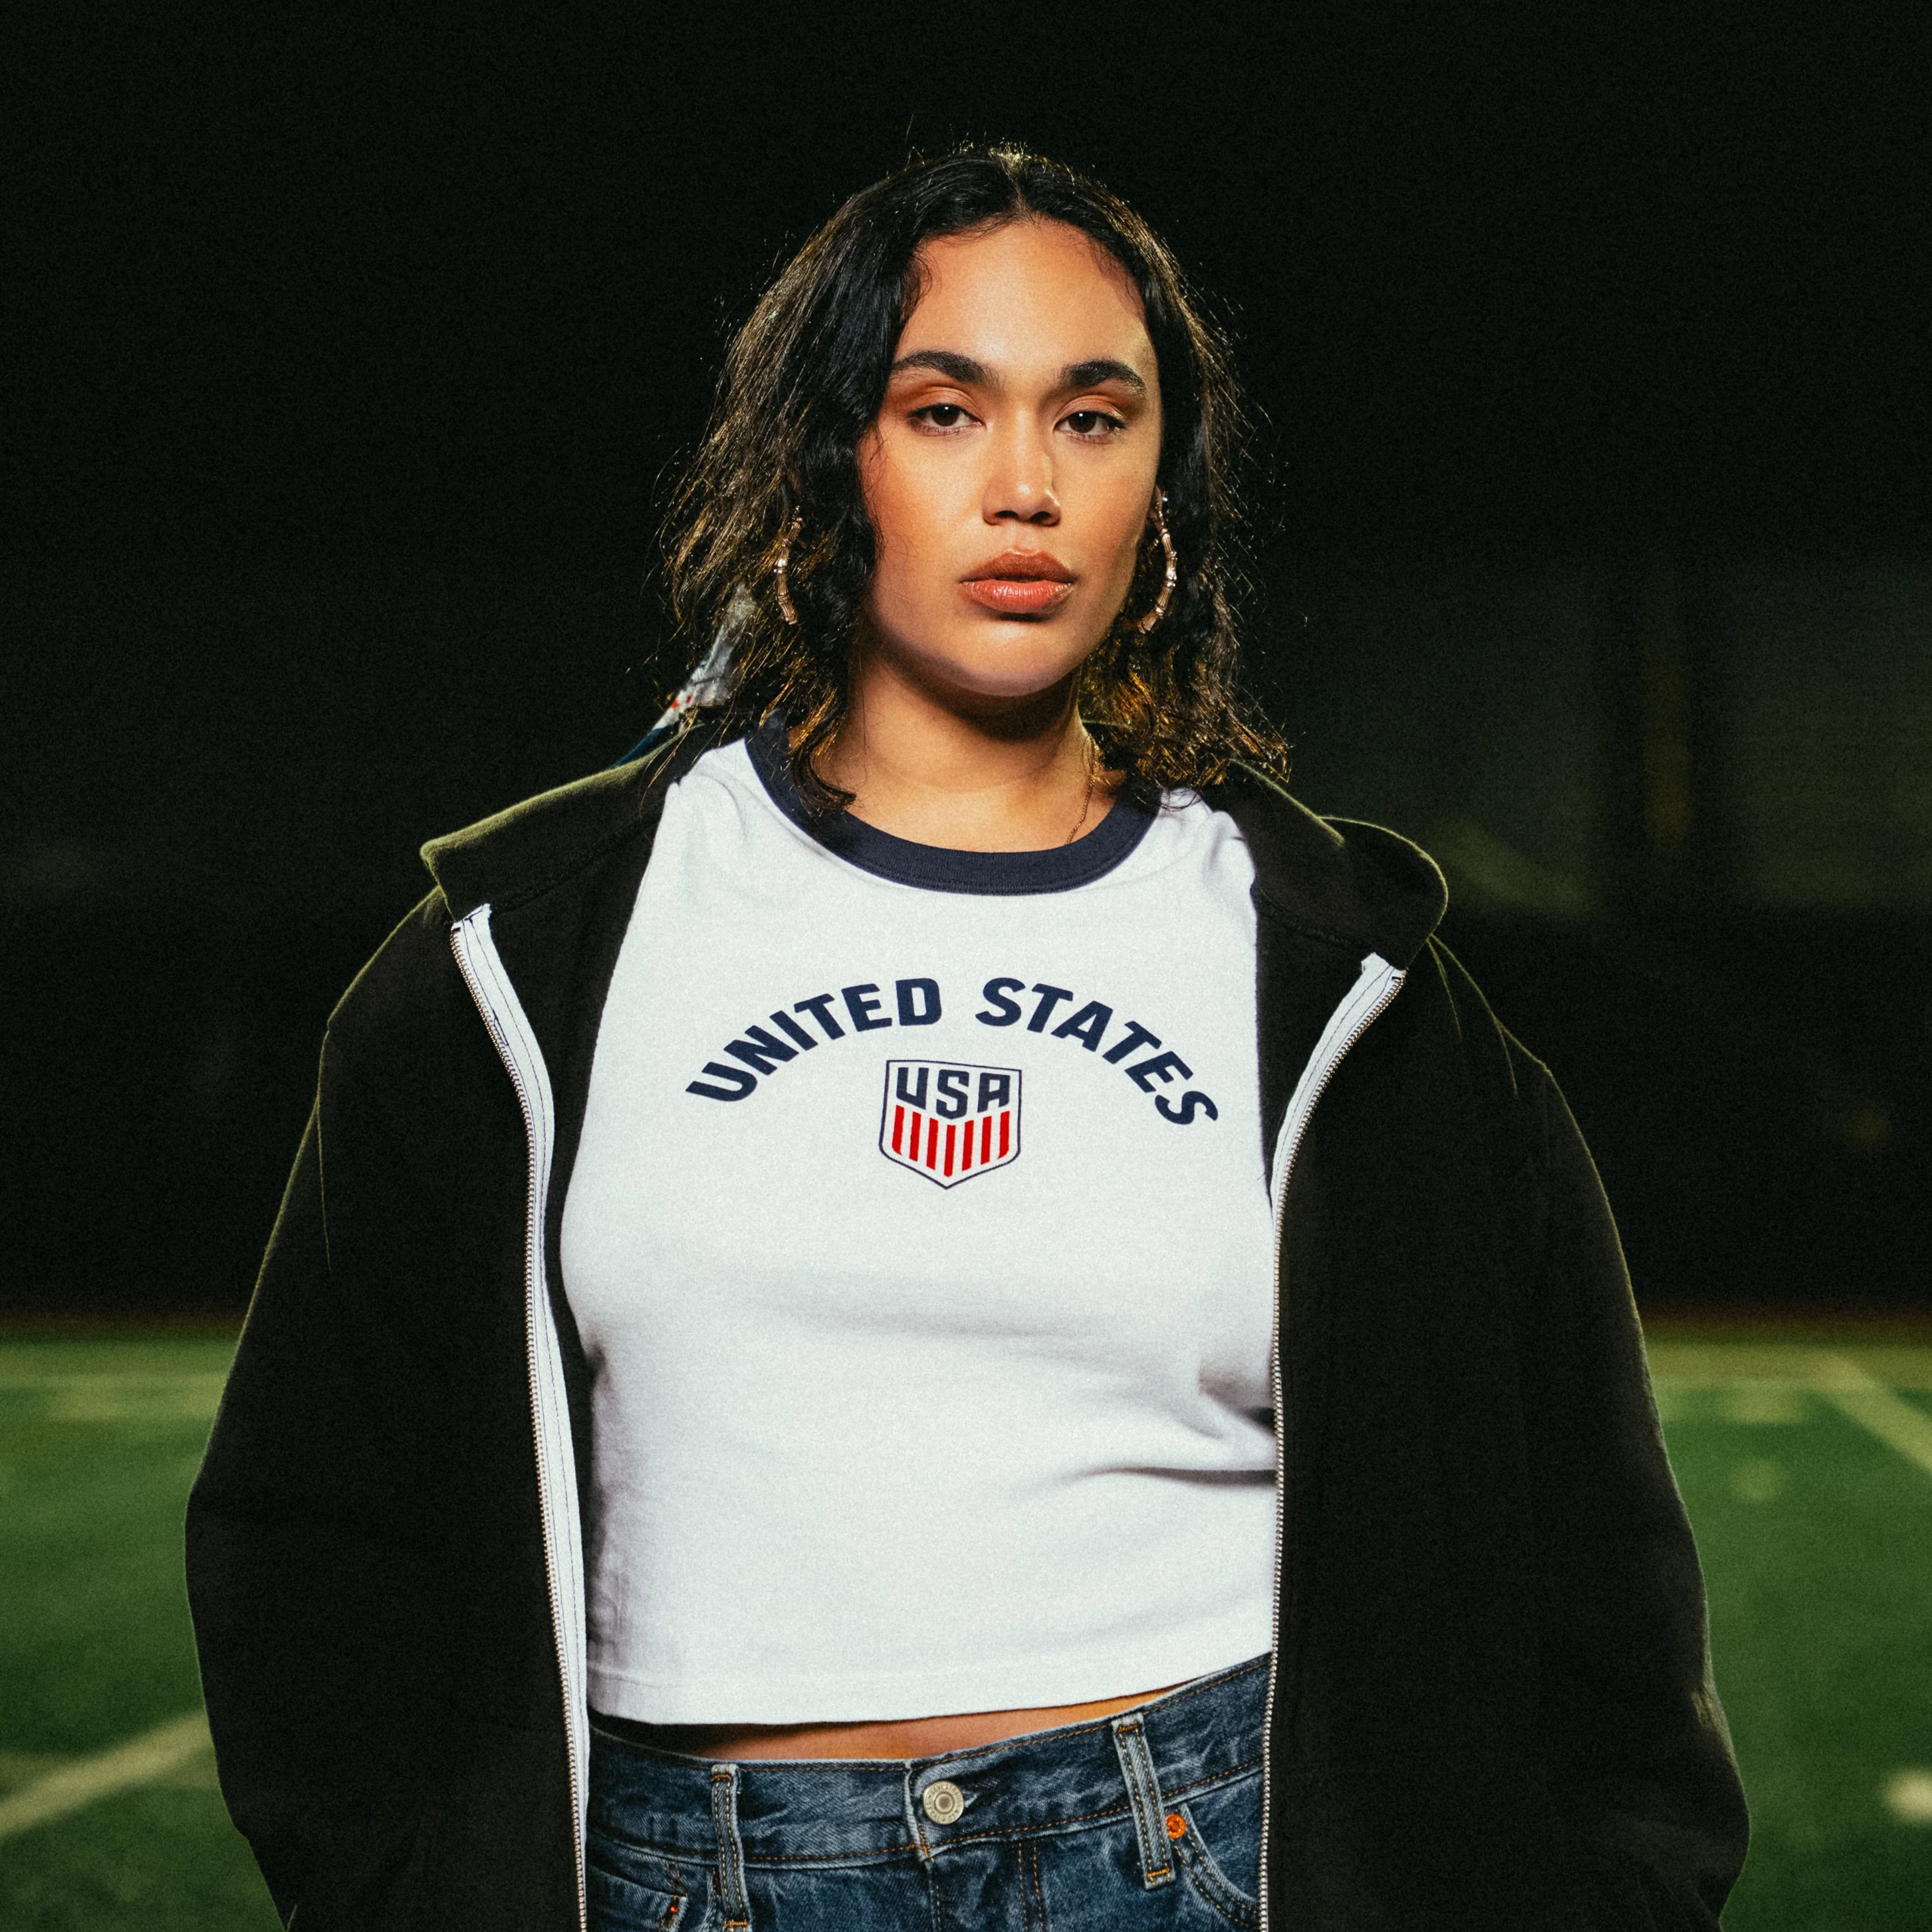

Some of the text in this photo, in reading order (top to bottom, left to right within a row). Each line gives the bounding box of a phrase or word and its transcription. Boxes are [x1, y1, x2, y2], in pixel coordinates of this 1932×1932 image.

[685, 977, 1218, 1125] UNITED STATES
[896, 1067, 1011, 1120] USA
